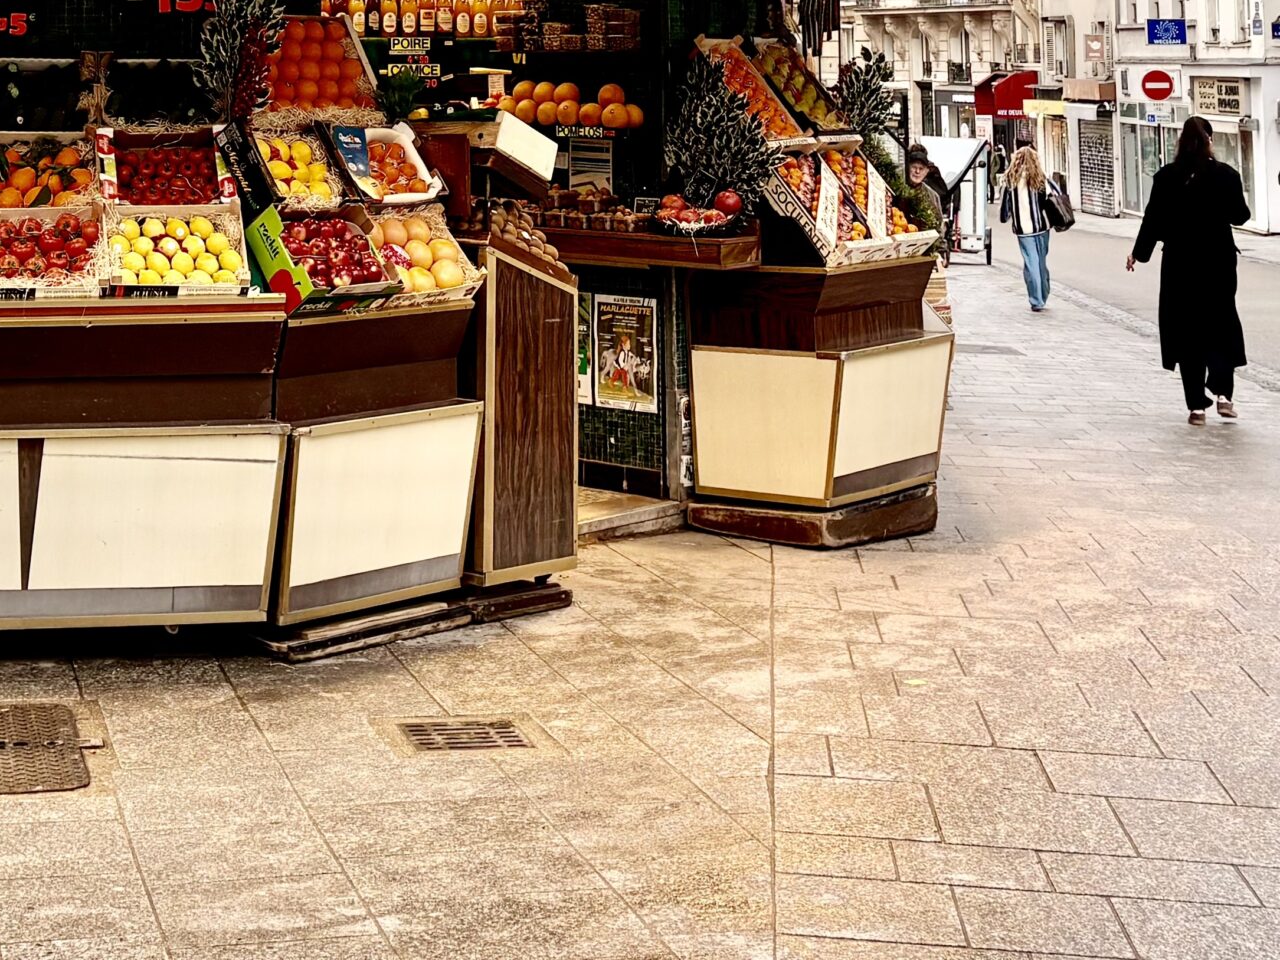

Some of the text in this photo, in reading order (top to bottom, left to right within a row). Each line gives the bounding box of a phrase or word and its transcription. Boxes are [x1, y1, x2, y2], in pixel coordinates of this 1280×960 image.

[392, 38, 430, 49] POIRE
[556, 126, 603, 137] POMELOS
[258, 222, 281, 258] rockit
